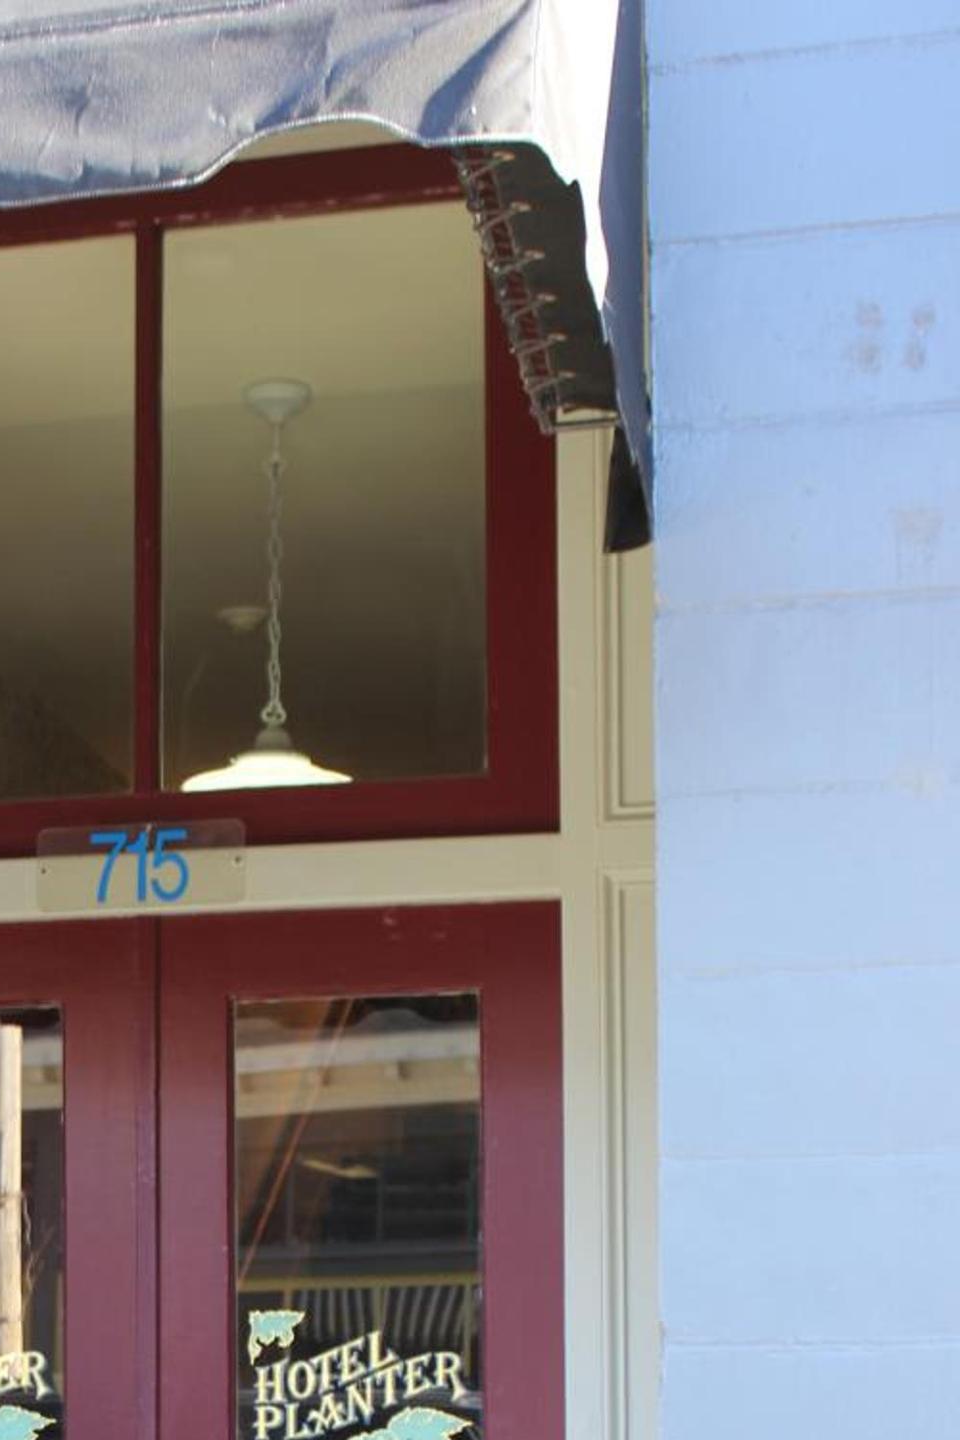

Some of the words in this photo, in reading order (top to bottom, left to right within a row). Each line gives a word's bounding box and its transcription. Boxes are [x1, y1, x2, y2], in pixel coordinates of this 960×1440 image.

[90, 829, 189, 903] 715
[252, 1351, 468, 1440] PLANTER
[254, 1330, 400, 1403] HOTEL
